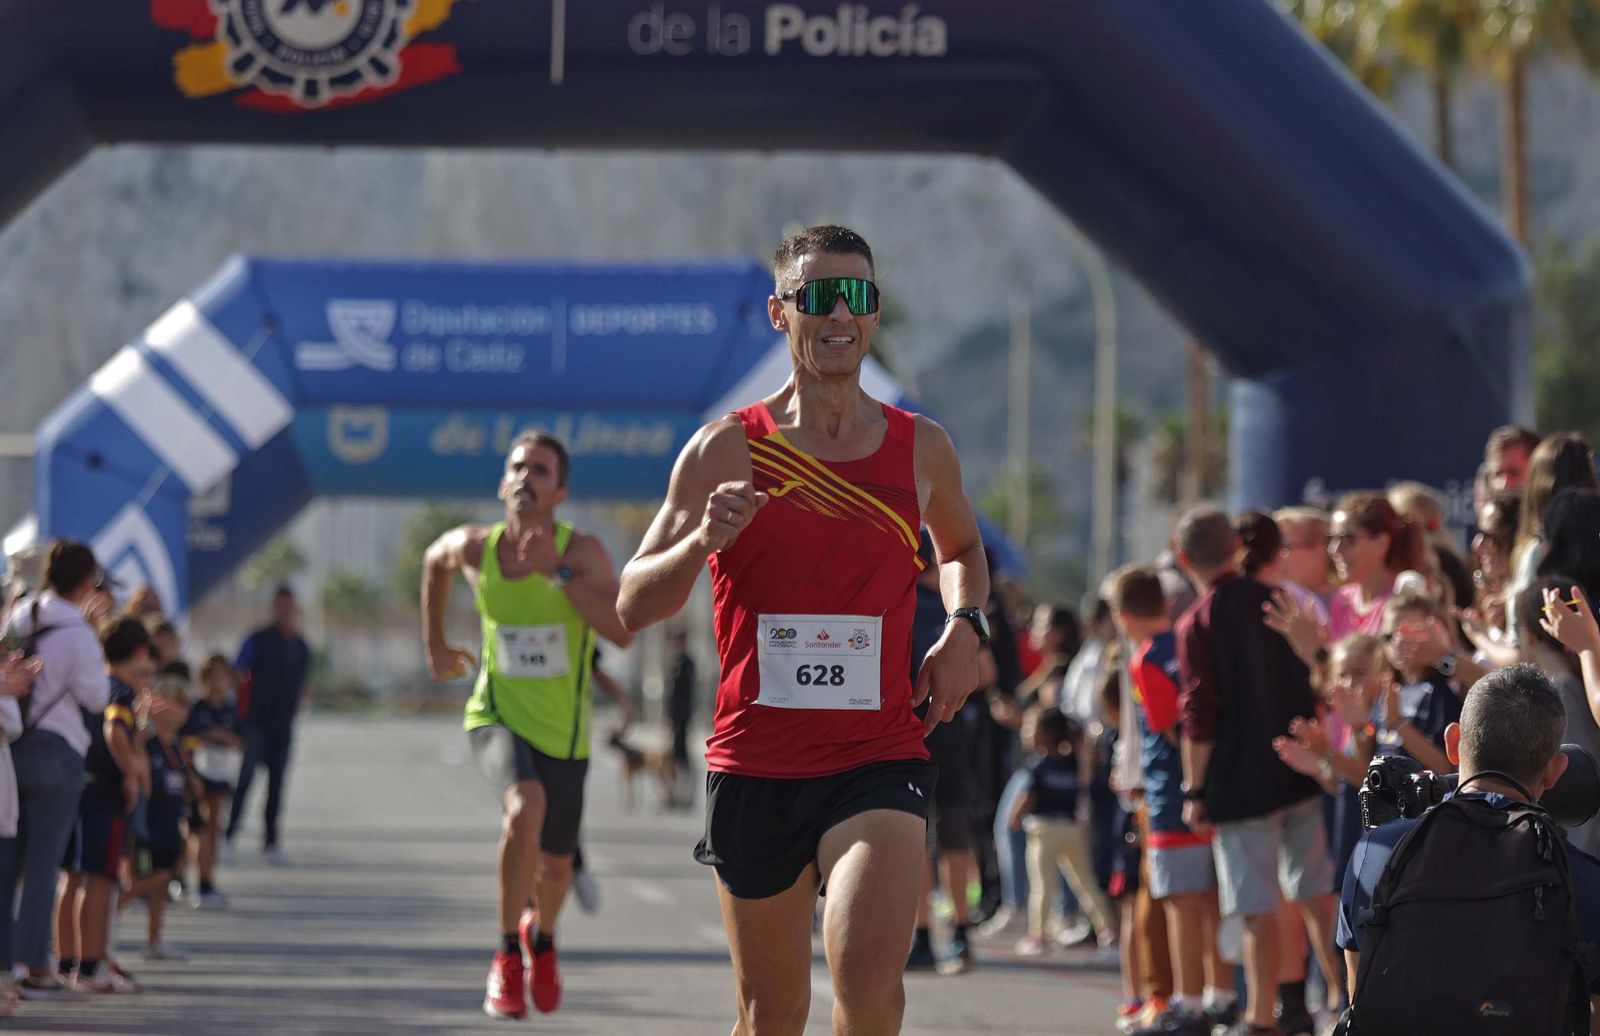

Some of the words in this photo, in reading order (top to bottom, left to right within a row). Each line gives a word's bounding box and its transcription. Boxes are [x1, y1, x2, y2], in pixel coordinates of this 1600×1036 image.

[627, 2, 697, 56] de
[706, 3, 750, 56] la
[766, 4, 948, 56] Policía
[403, 301, 550, 337] Diputación
[571, 304, 716, 335] DEPORTES
[402, 342, 441, 373] de
[431, 415, 485, 455] de
[804, 641, 841, 649] Santander
[796, 664, 845, 687] 628
